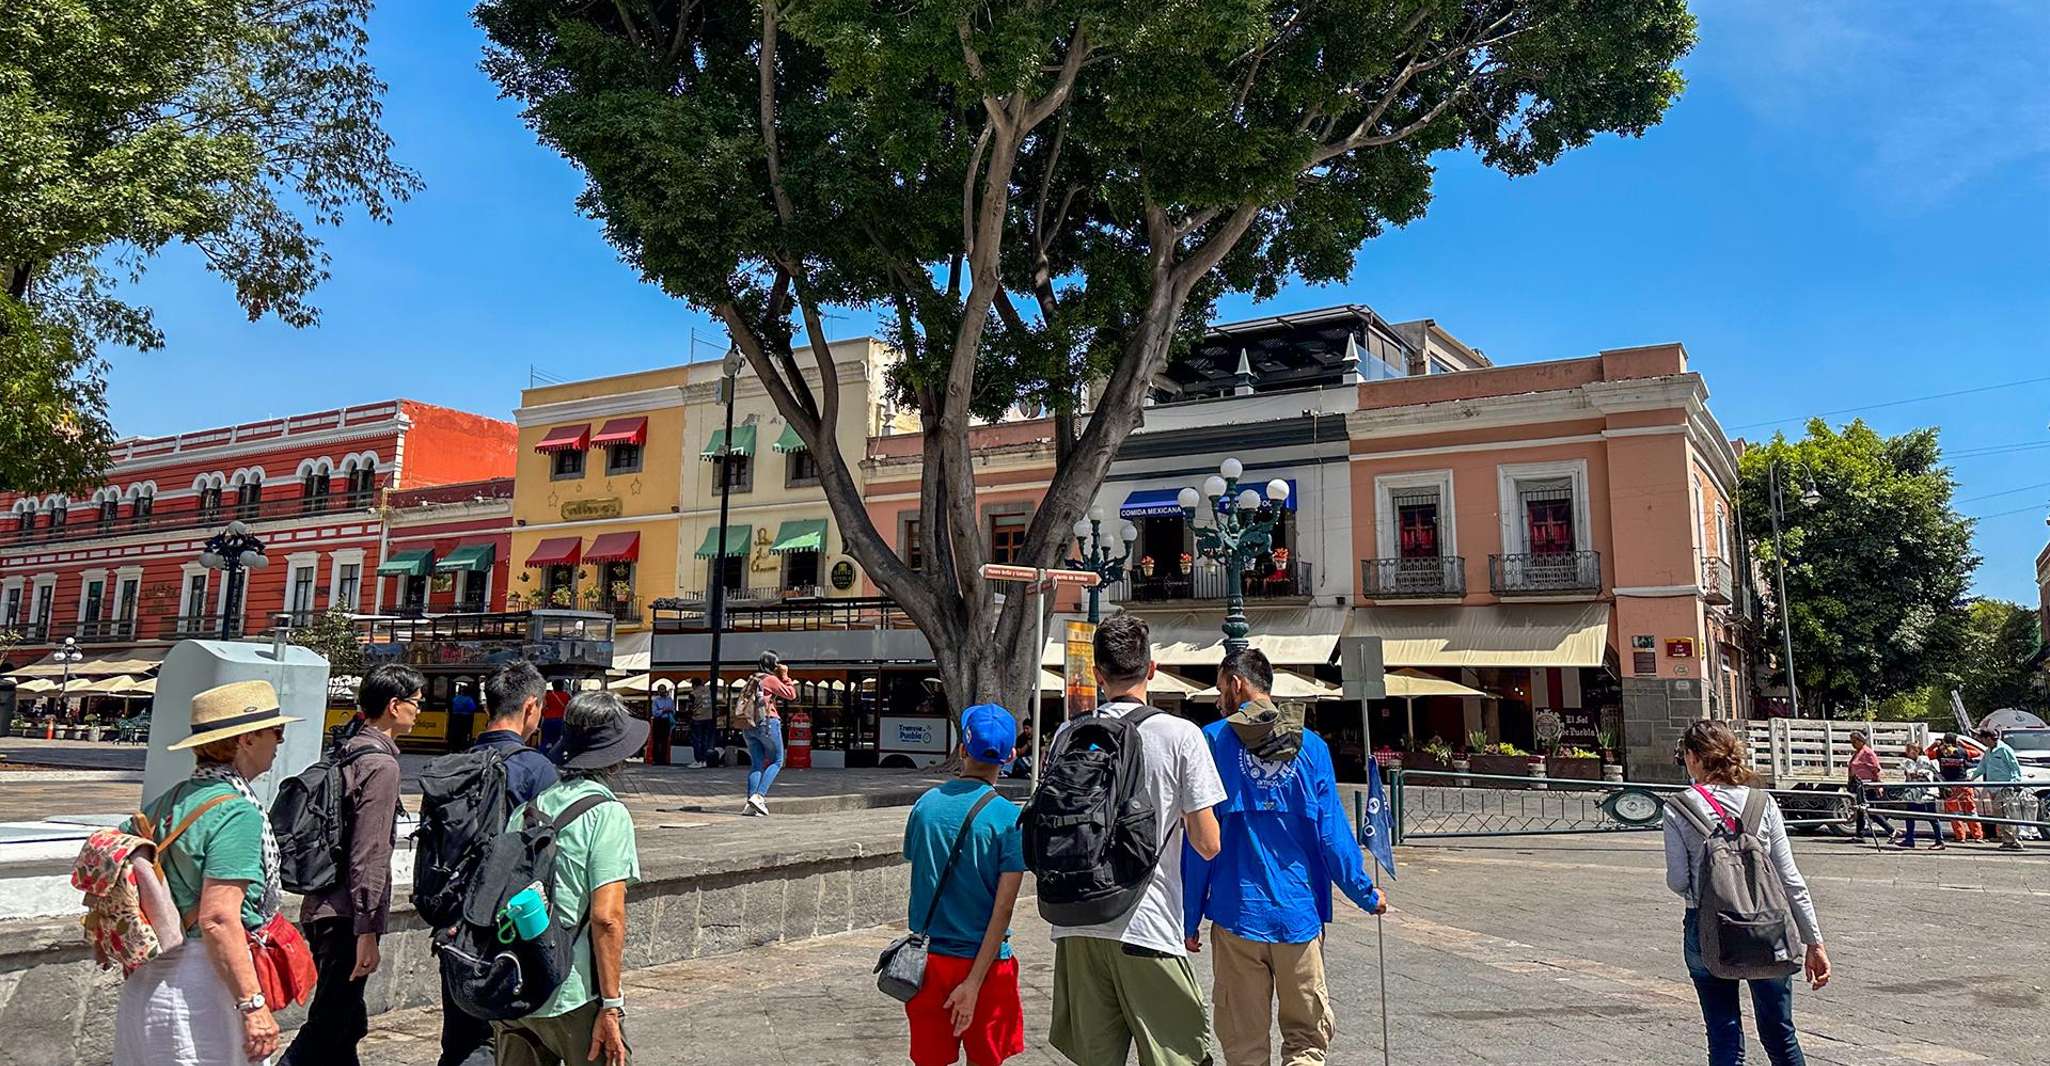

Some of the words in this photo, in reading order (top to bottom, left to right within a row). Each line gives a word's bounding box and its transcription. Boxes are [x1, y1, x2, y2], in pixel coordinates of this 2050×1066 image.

[1120, 508, 1147, 517] COMIDA
[1147, 507, 1182, 515] MEXICANA
[1565, 714, 1574, 724] El
[1575, 715, 1589, 724] Sol
[1569, 726, 1595, 737] Puebla
